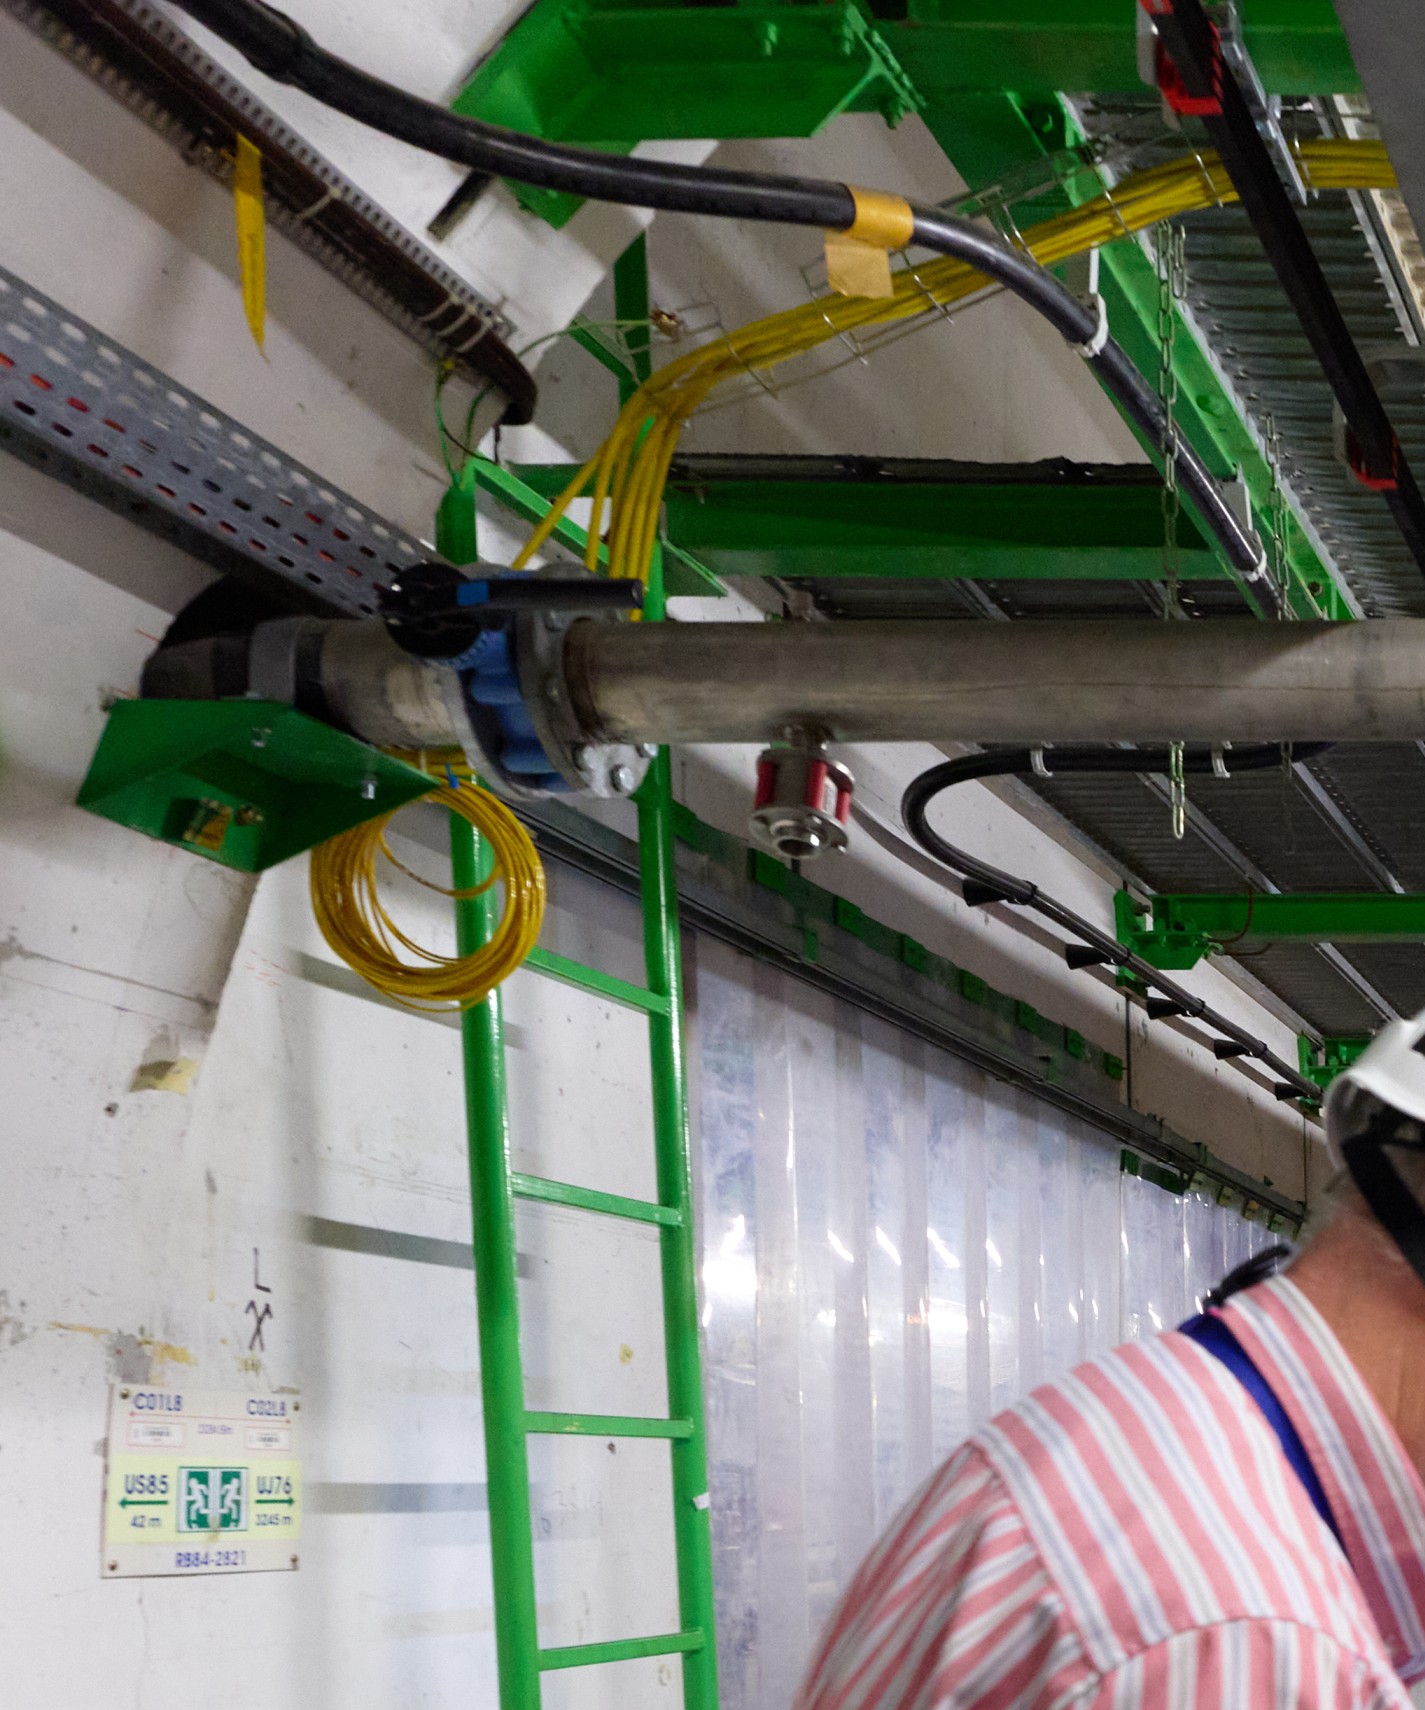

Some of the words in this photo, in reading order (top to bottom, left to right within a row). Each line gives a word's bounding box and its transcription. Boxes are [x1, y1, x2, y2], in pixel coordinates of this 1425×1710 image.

[124, 1474, 169, 1495] US85
[256, 1476, 292, 1495] UJ76
[130, 1514, 146, 1528] 42
[148, 1516, 162, 1528] m
[282, 1515, 293, 1526] m
